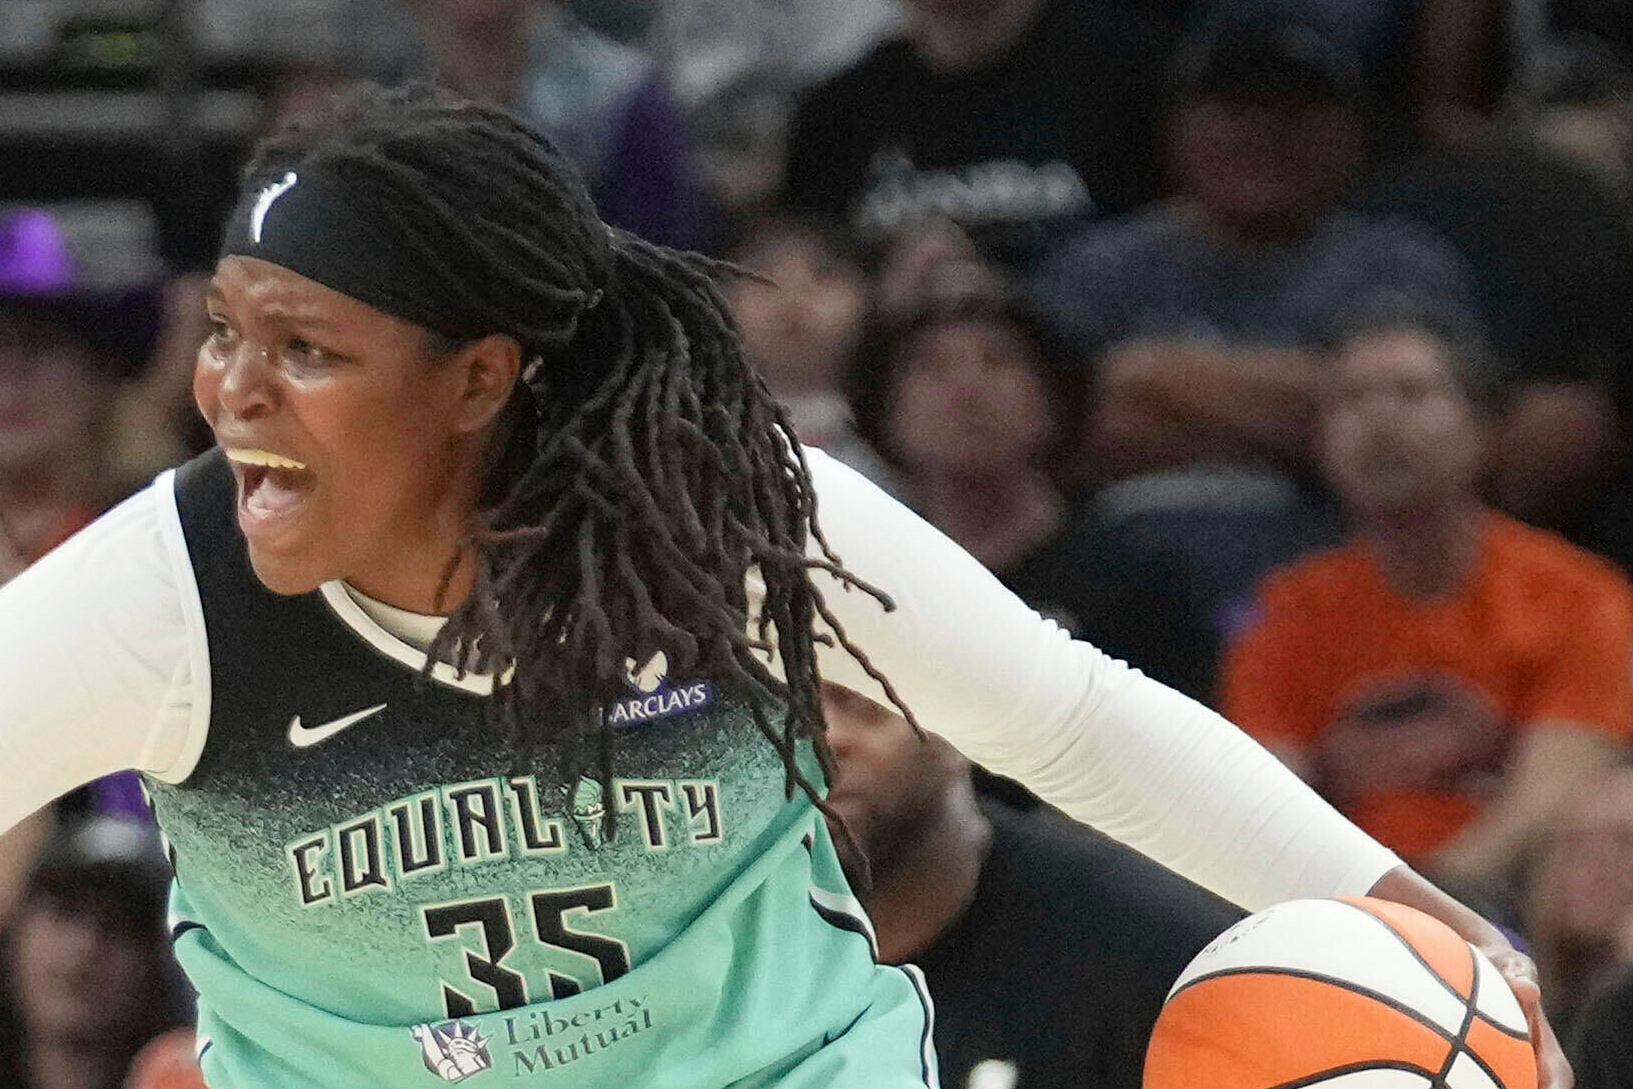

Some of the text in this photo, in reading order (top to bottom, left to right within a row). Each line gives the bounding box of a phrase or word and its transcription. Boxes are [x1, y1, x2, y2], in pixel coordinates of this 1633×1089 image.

[609, 684, 707, 724] ARCLAYS
[422, 883, 632, 1019] 35
[503, 994, 649, 1046] Liberty
[514, 1008, 653, 1077] Mutual
